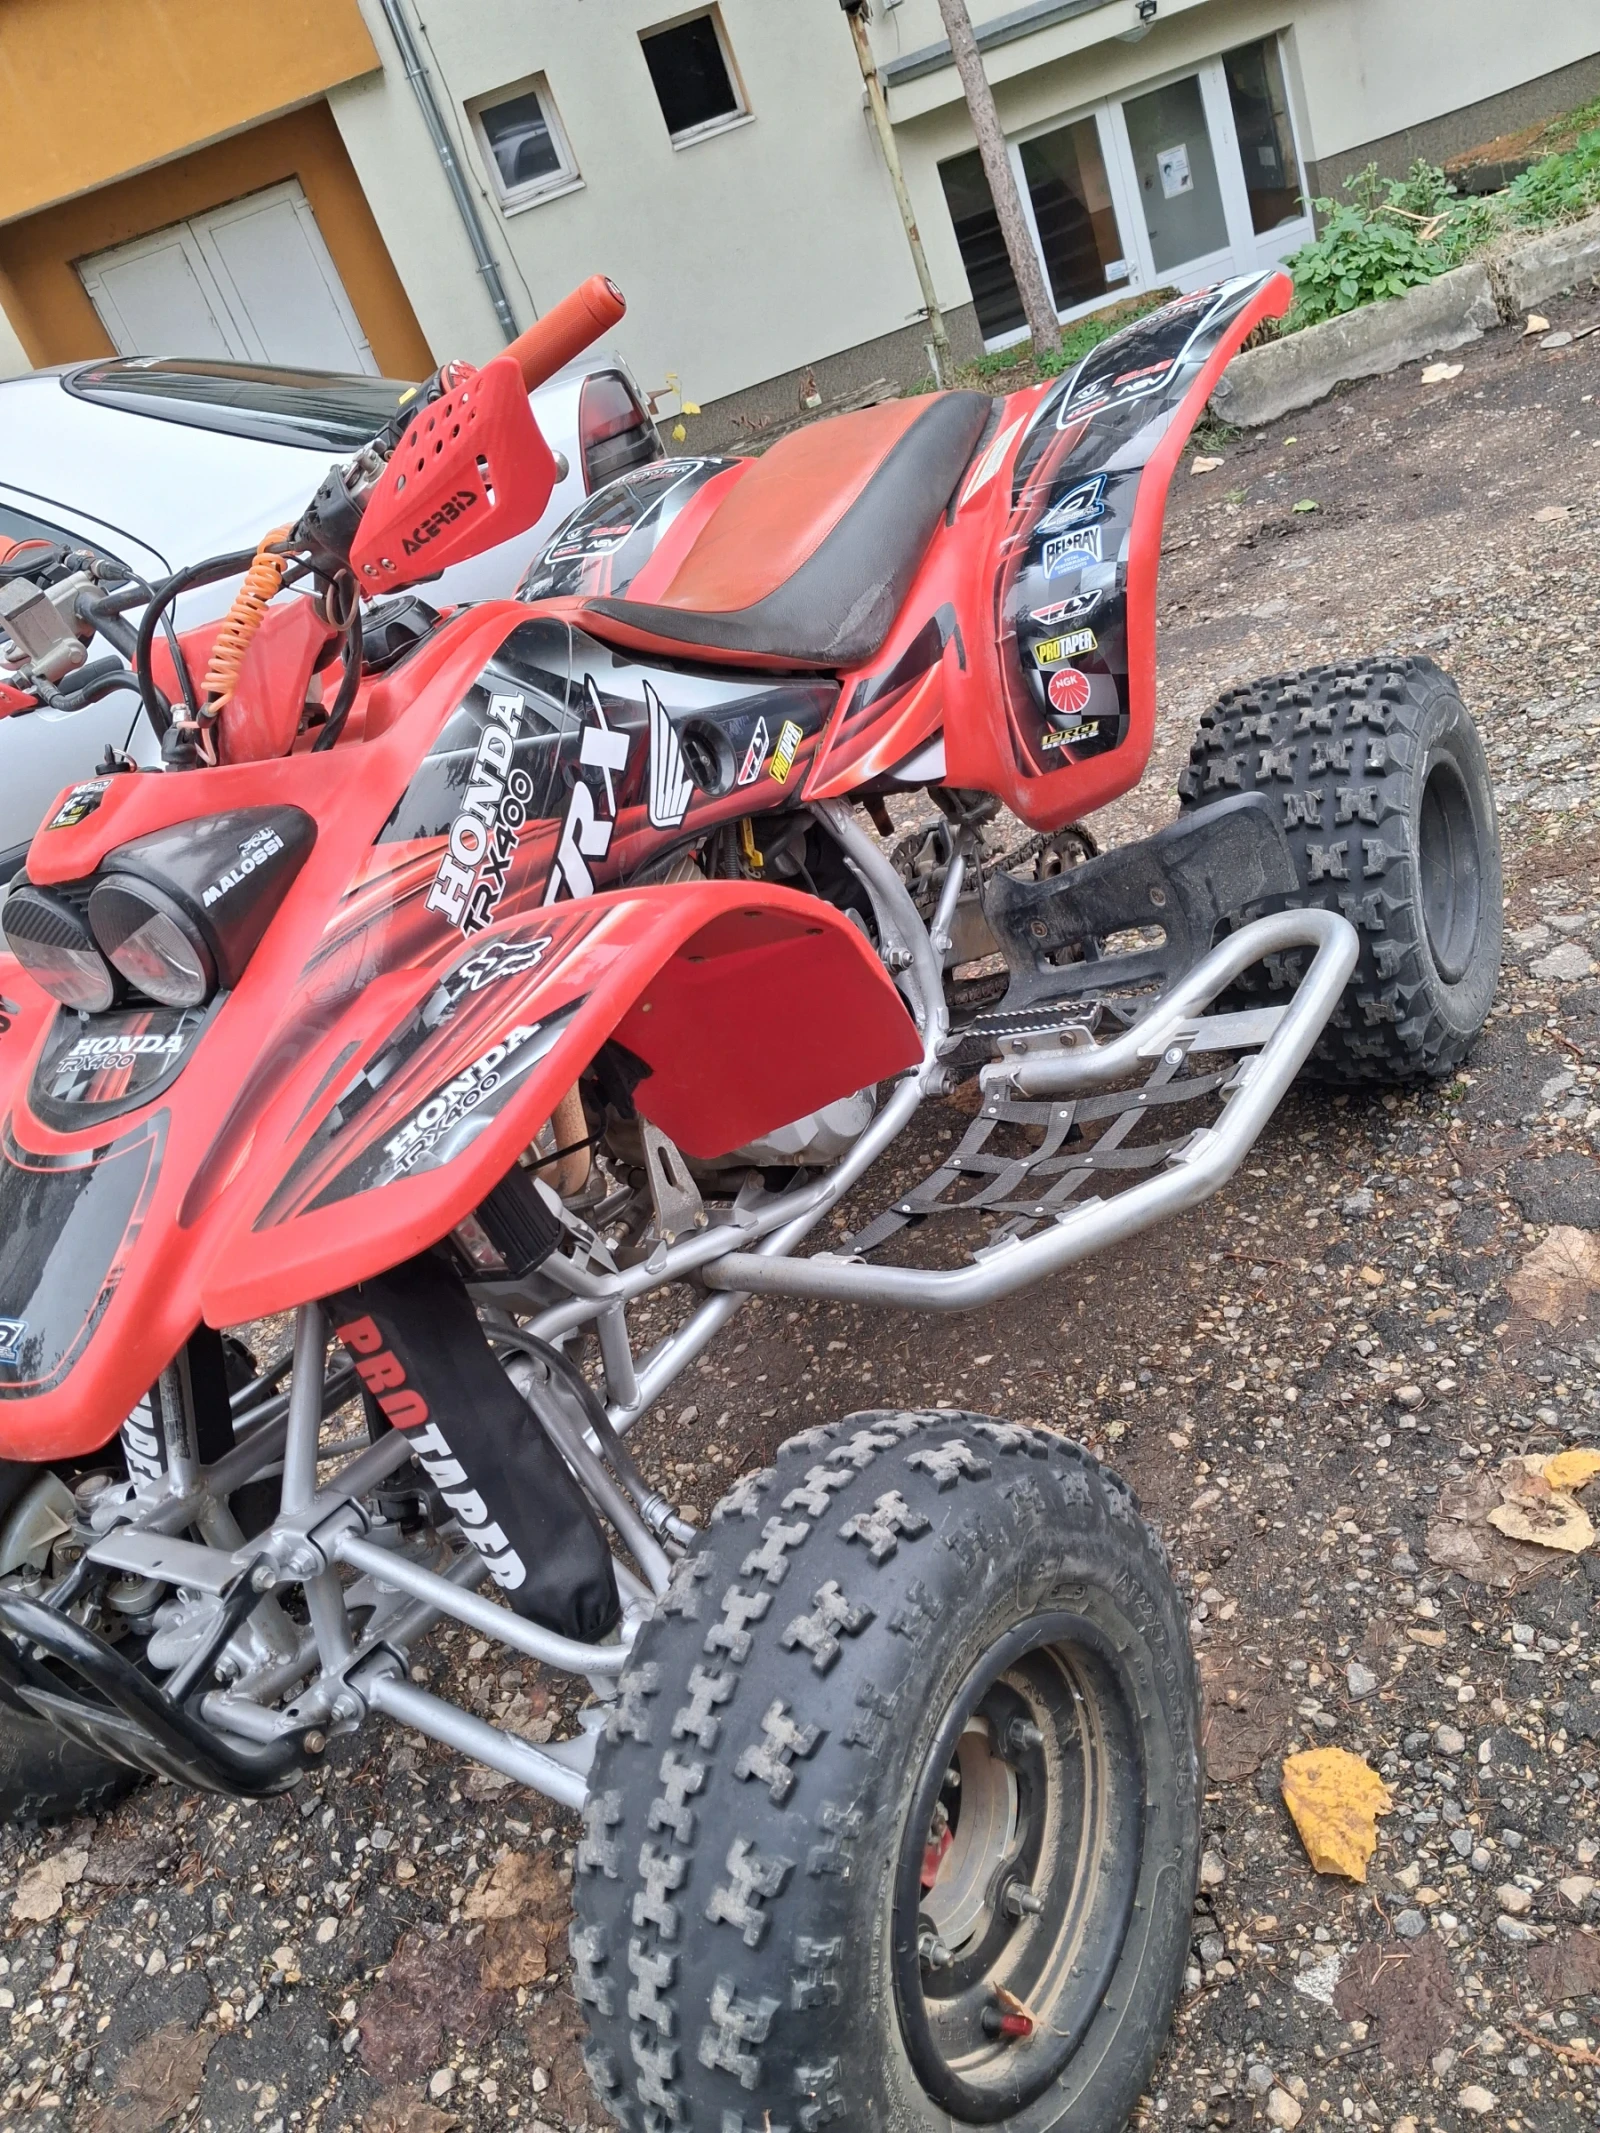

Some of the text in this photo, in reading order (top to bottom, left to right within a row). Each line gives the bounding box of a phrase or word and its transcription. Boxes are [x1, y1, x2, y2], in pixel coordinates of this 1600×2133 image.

[402, 491, 478, 556] ACERBIS
[1055, 675, 1078, 689] NGK
[424, 692, 525, 927] HONDA
[202, 835, 284, 907] MALOSSI
[460, 769, 533, 940] TRX400
[56, 1053, 137, 1073] TRX400
[68, 1034, 184, 1056] HONDA
[383, 1023, 542, 1160] HONDA
[394, 1072, 500, 1172] TRX400
